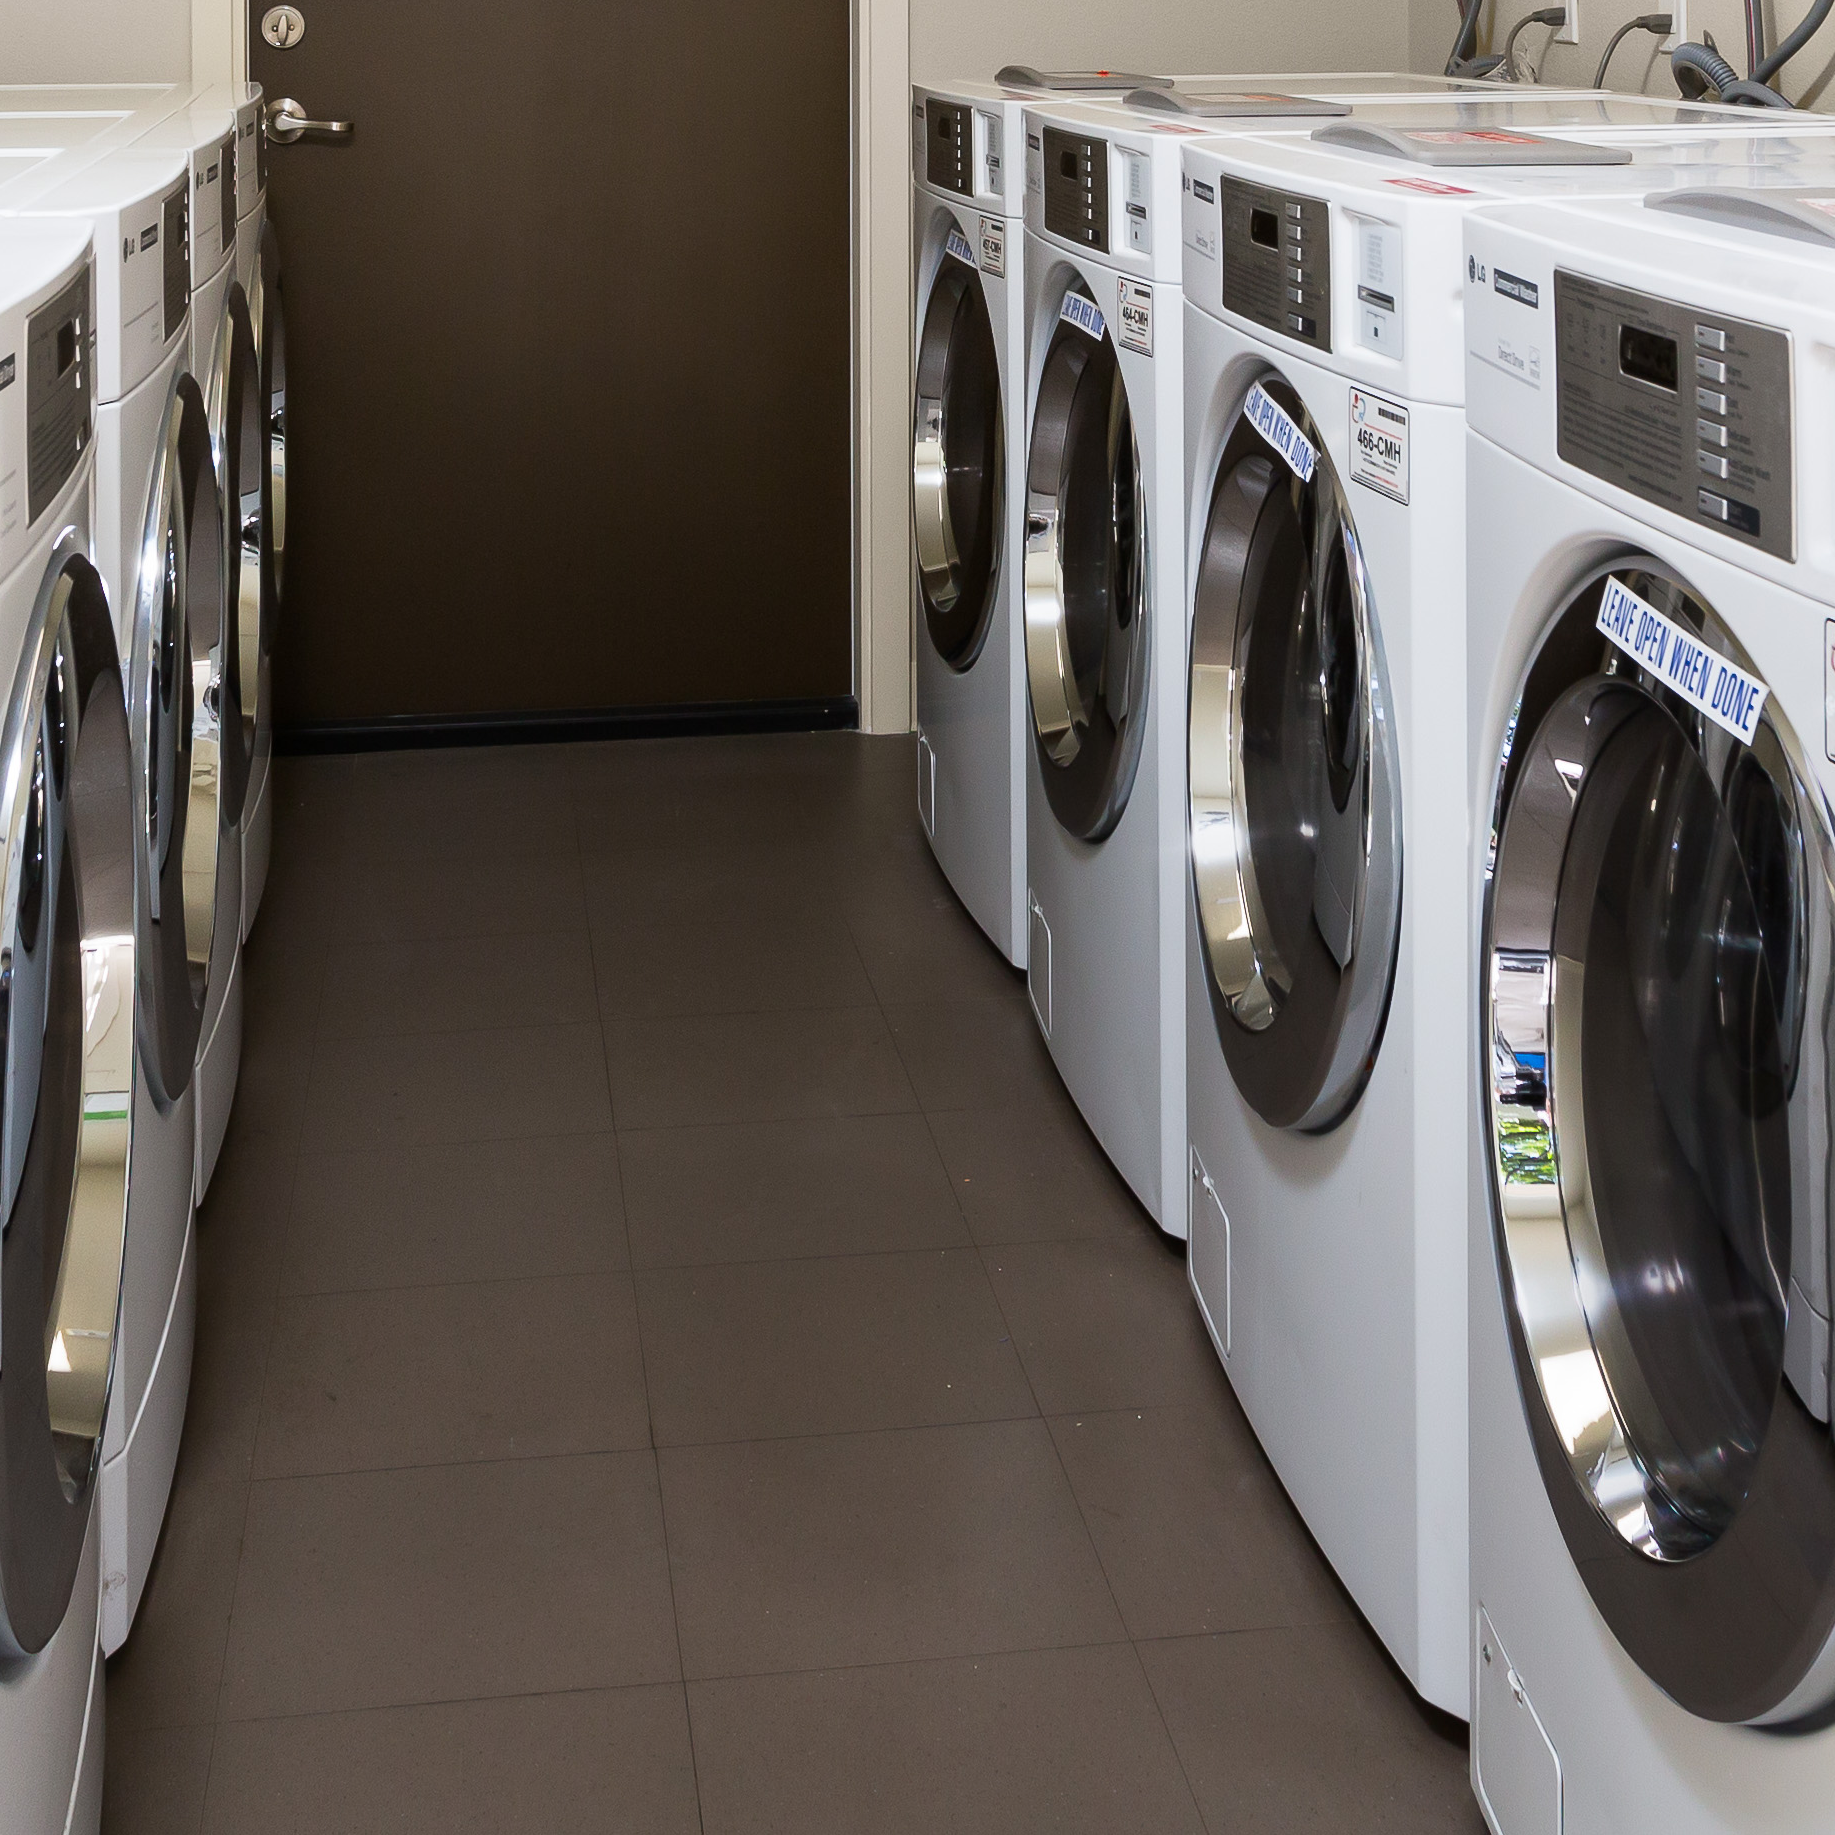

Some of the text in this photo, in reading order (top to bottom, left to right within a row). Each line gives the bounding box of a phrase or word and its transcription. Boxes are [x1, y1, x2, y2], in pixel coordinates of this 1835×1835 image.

[1258, 399, 1275, 436] OPEN
[1272, 415, 1295, 453] WHEN
[1290, 435, 1313, 482] DONE
[1357, 427, 1400, 463] 466-CMH
[1601, 584, 1759, 731] LEAVE OPEN WHEN DONE
